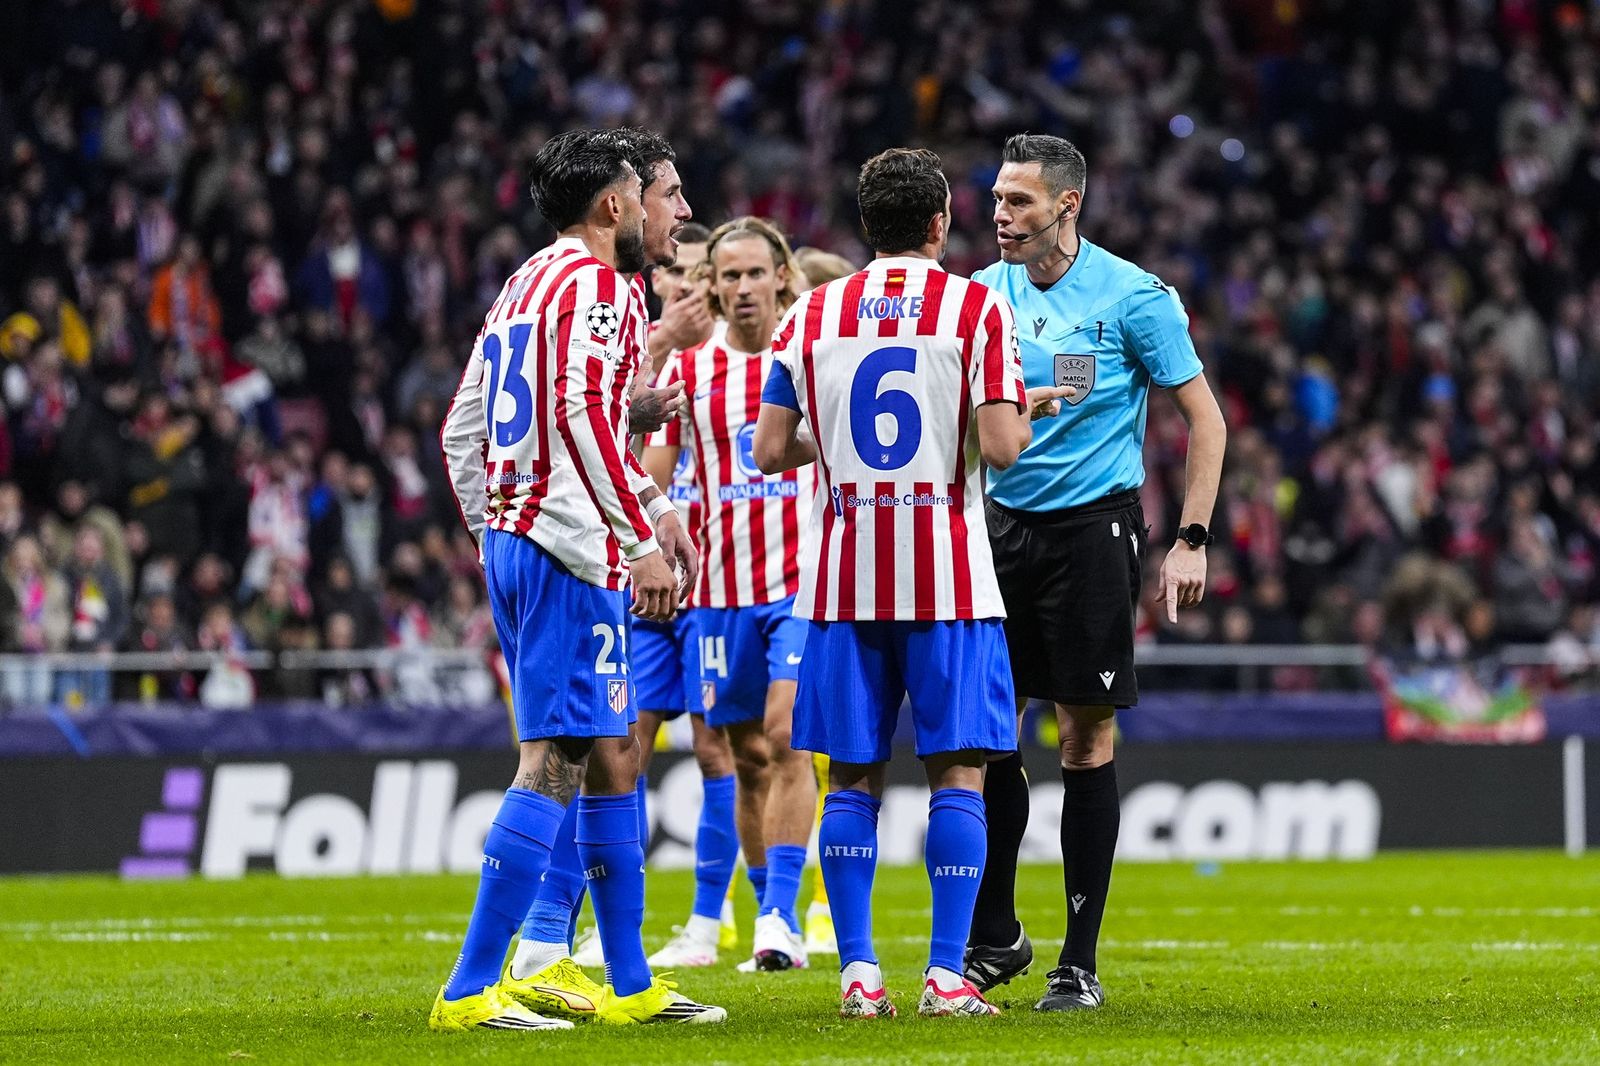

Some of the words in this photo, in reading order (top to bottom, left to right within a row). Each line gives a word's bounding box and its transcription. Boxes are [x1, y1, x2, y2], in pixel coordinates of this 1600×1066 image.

[857, 295, 923, 320] KOKE
[1061, 360, 1086, 371] UEFA
[850, 346, 922, 471] 6
[720, 483, 765, 501] RIYADH
[770, 481, 798, 497] AIR
[848, 494, 876, 507] Save
[879, 494, 900, 507] the
[903, 493, 953, 507] Children
[698, 635, 728, 679] 14
[825, 845, 873, 859] ATLETI
[934, 865, 979, 878] ATLETI
